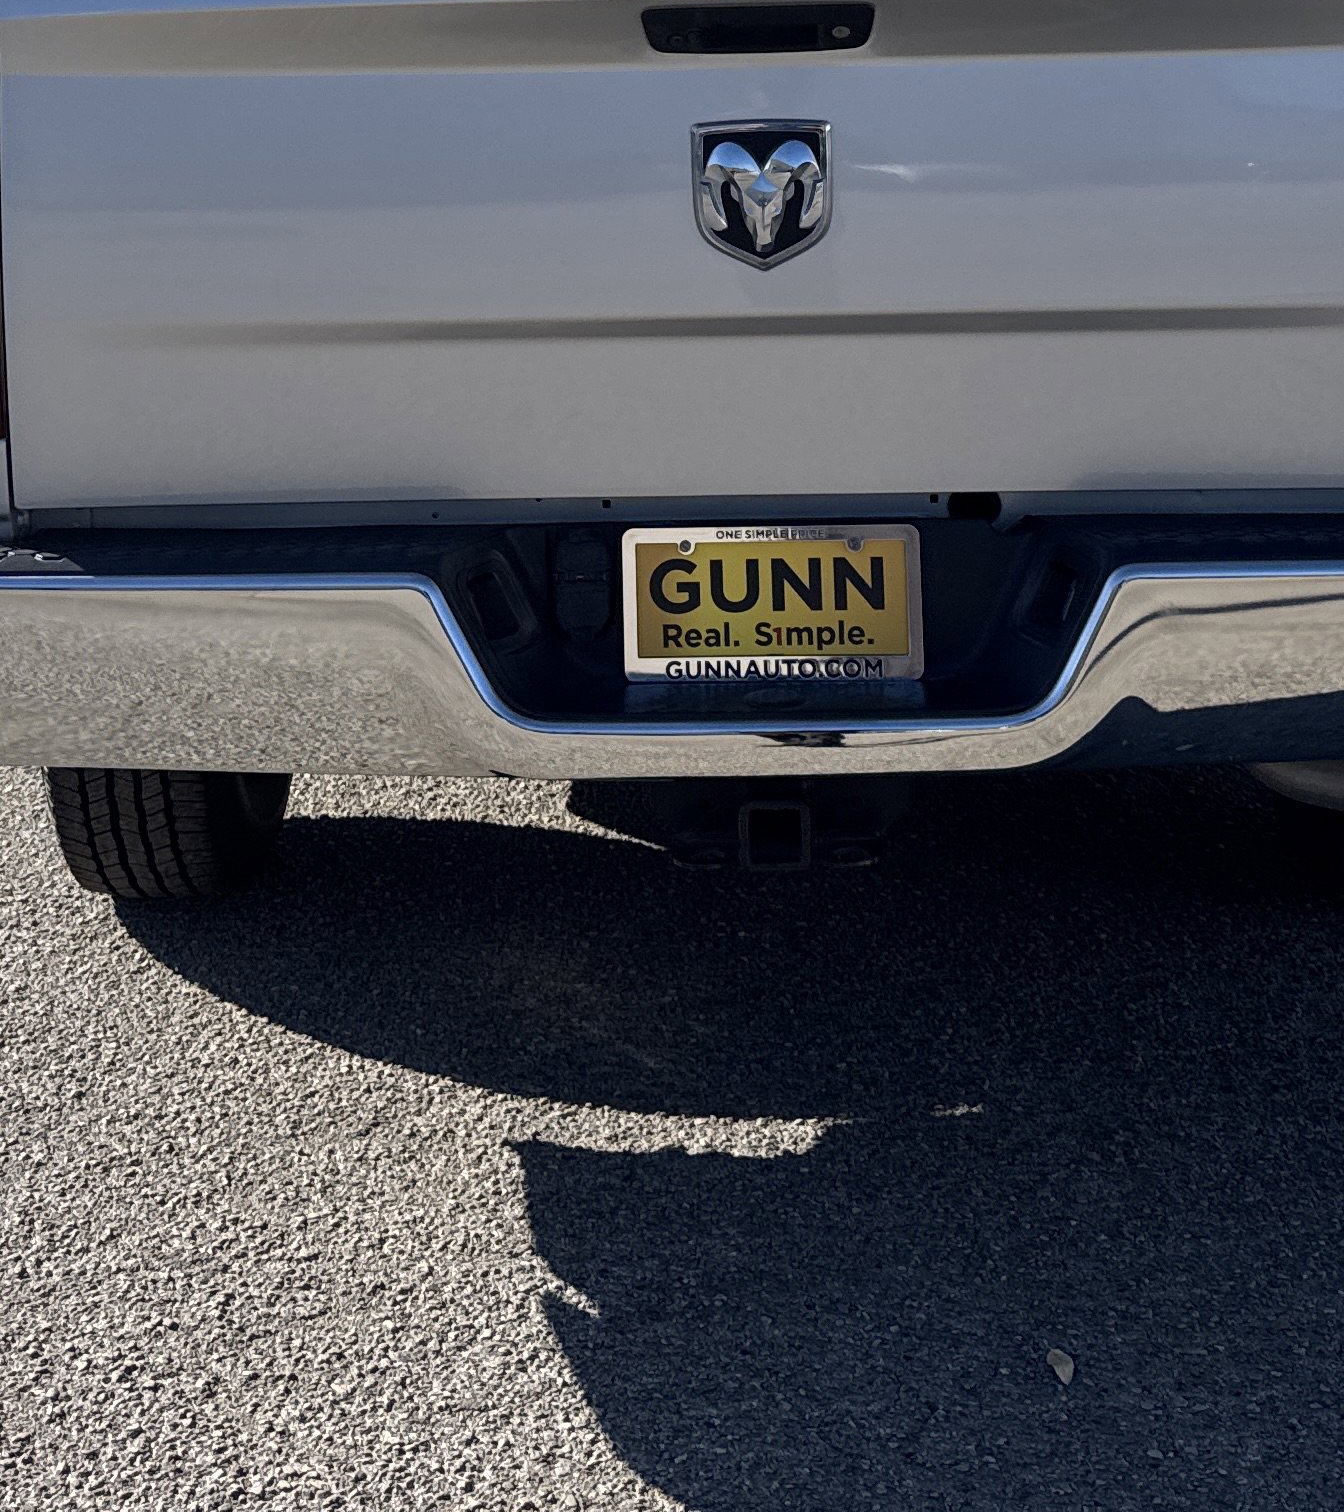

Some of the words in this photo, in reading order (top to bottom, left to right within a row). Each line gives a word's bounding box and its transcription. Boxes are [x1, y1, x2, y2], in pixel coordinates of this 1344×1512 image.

[716, 529, 742, 540] ONE
[744, 528, 788, 539] SIMPLE
[649, 556, 885, 614] GUNN
[662, 622, 740, 648] Real.
[665, 658, 884, 681] GUNNAUTO.COM
